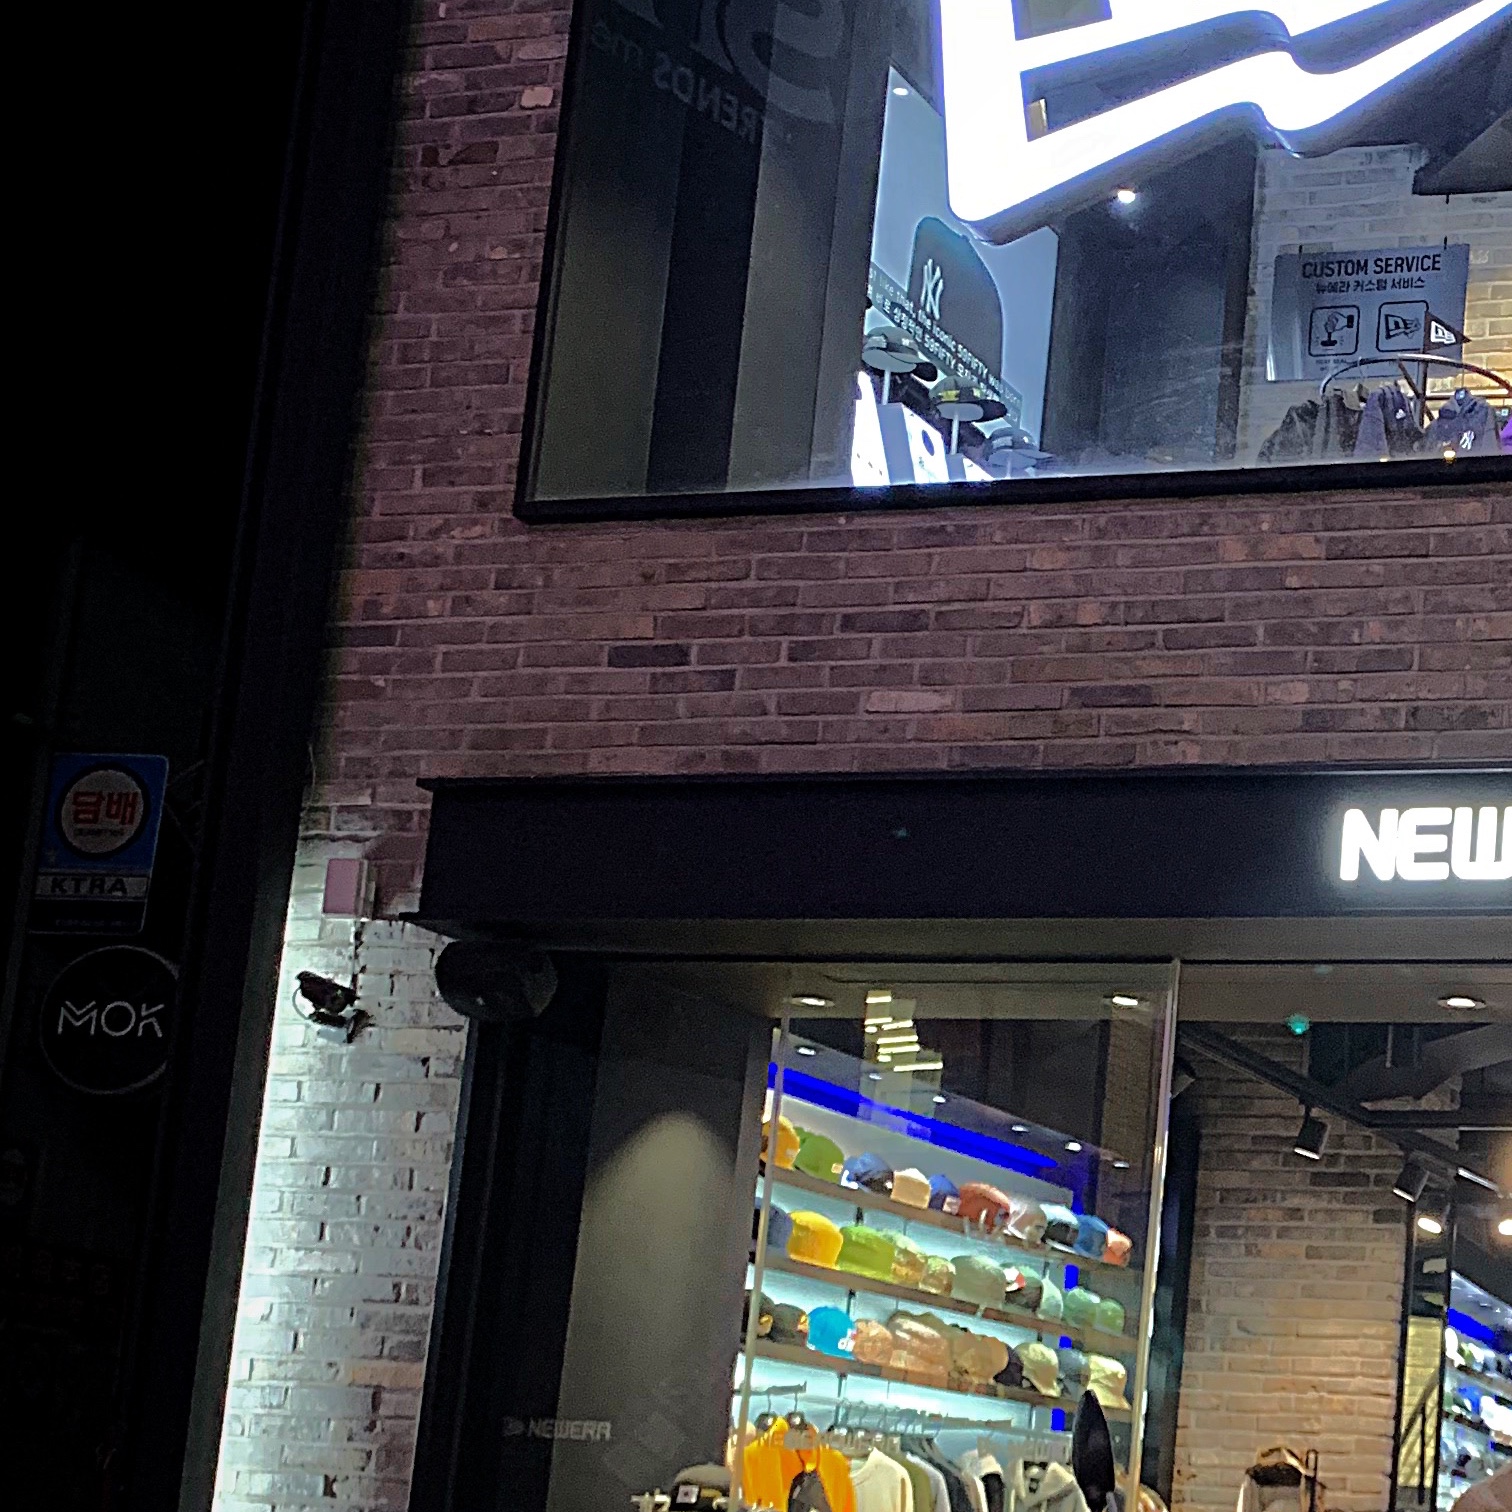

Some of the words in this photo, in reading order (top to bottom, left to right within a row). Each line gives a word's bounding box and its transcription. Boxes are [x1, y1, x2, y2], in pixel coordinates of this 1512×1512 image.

[1302, 259, 1369, 278] CUSTOM
[1373, 254, 1441, 275] SERVICE
[1316, 281, 1349, 294] 뉴에라
[1353, 279, 1388, 292] 커스텀
[1391, 276, 1426, 290] 서비스
[57, 1000, 165, 1038] MOK
